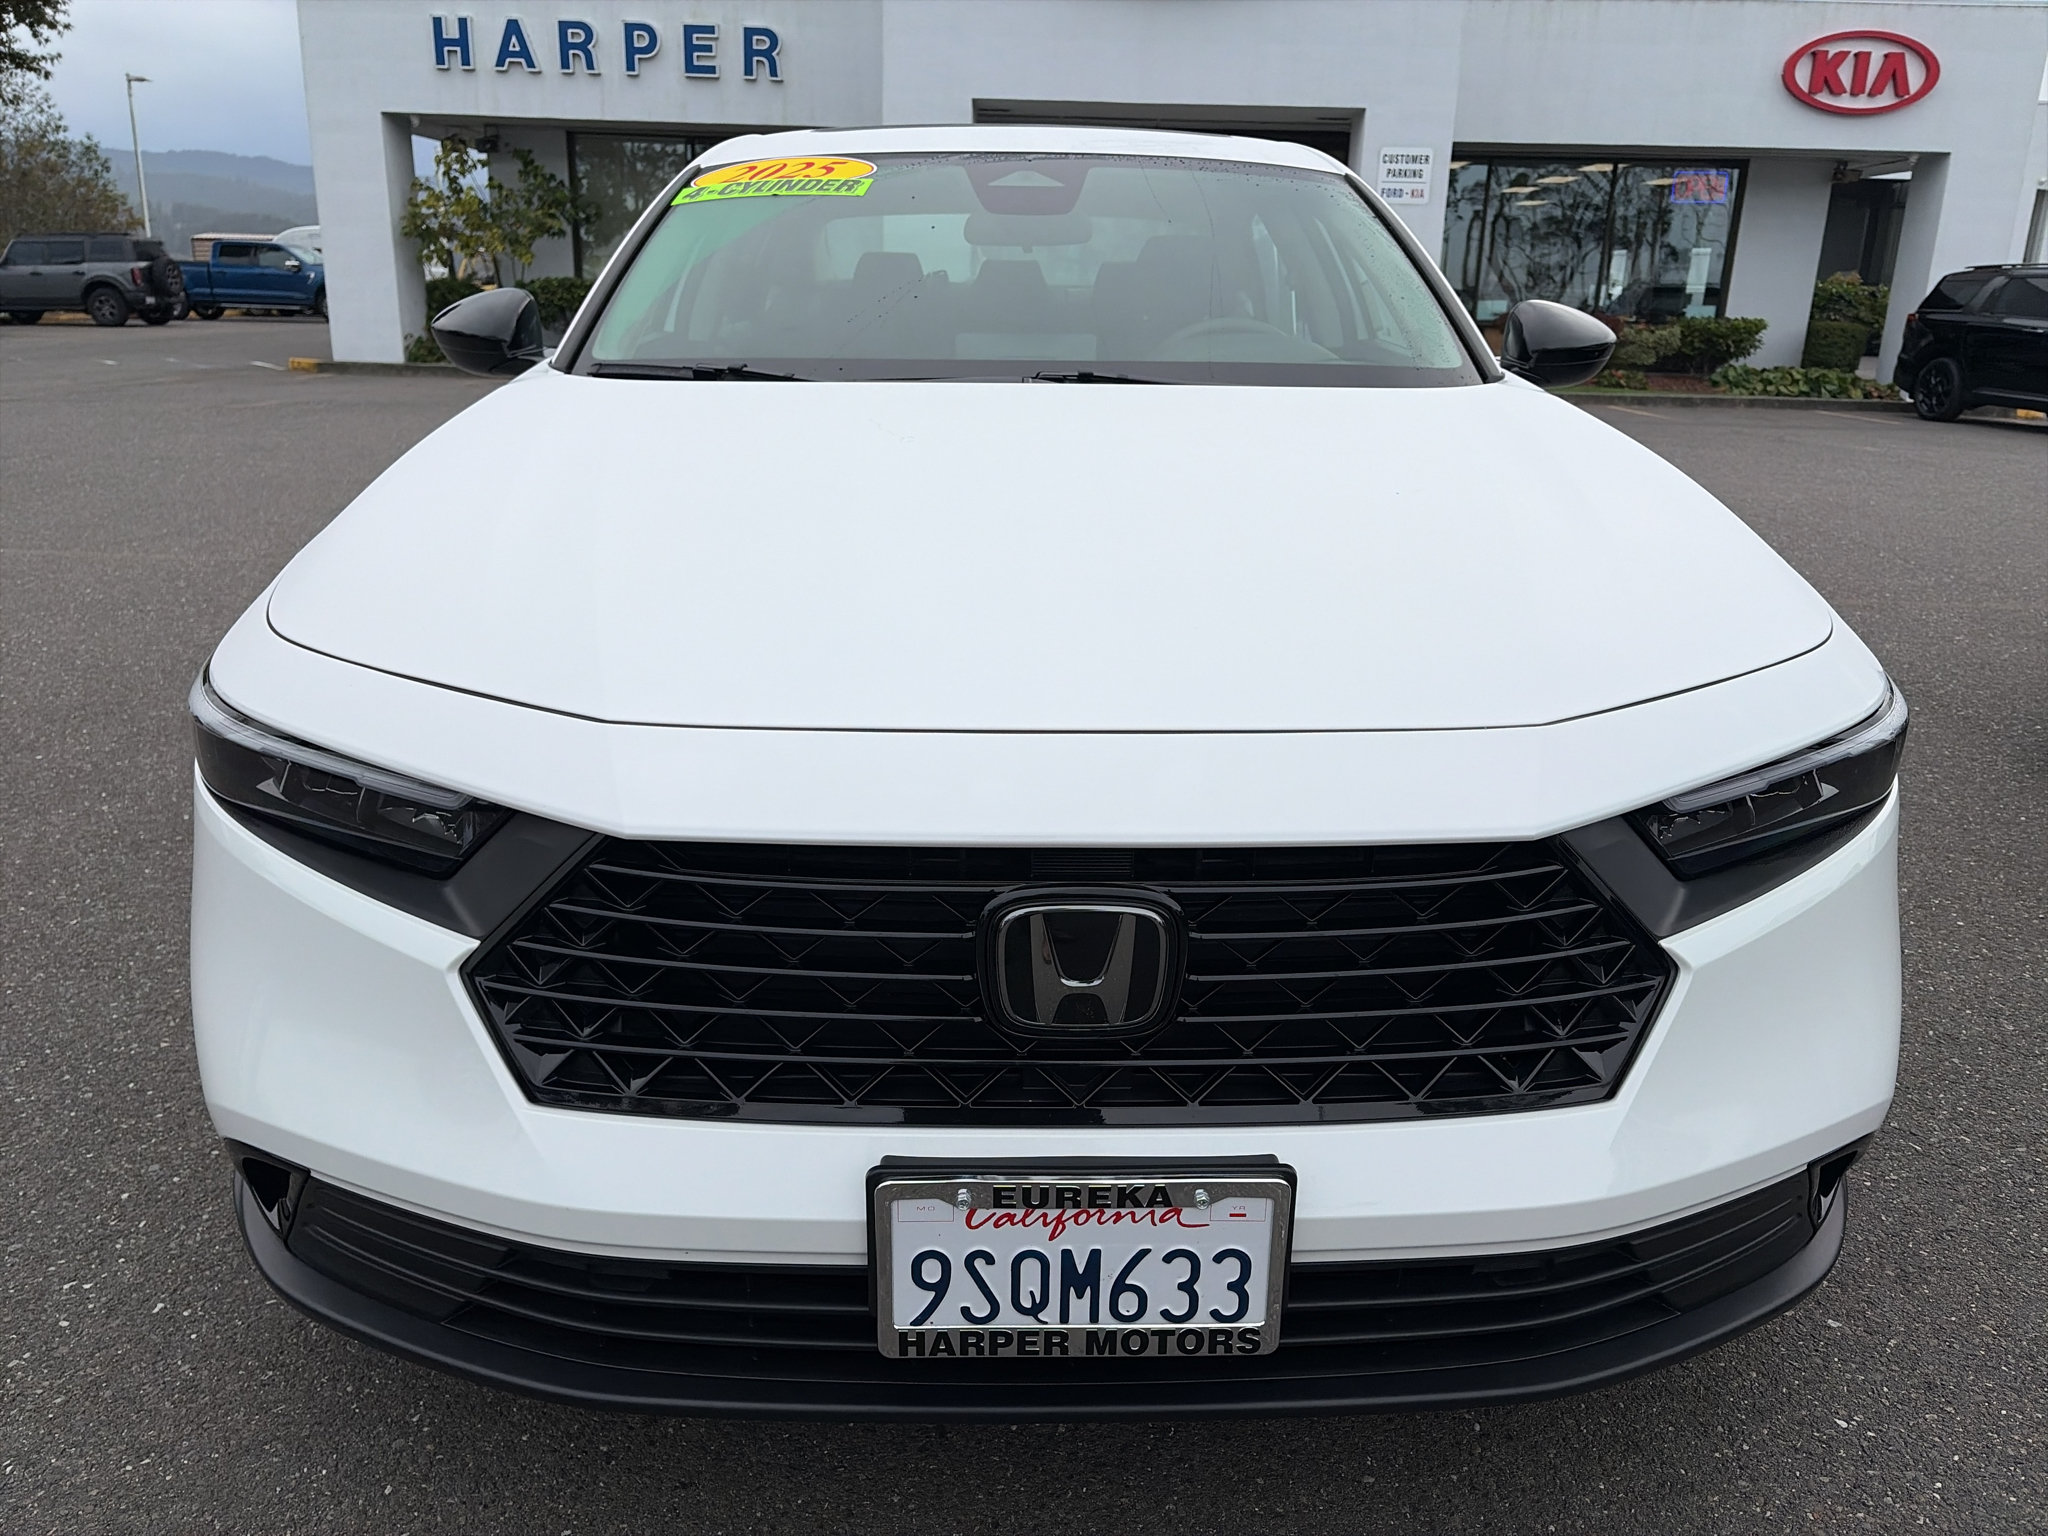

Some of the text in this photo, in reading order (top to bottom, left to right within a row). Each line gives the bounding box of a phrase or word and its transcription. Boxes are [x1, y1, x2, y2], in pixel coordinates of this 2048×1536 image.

[431, 15, 784, 82] HARPER
[1809, 49, 1910, 98] KIA
[1382, 154, 1430, 165] CUSTOMER
[720, 162, 849, 184] 2025
[1386, 168, 1424, 179] PARKING
[682, 179, 864, 200] 4-CYLINDER
[1381, 187, 1425, 199] FORD KIA
[992, 1184, 1174, 1209] EUREKA
[965, 1207, 1210, 1241] California
[909, 1247, 1253, 1326] 9SQM633
[899, 1327, 1262, 1357] HARPER MOTORS
